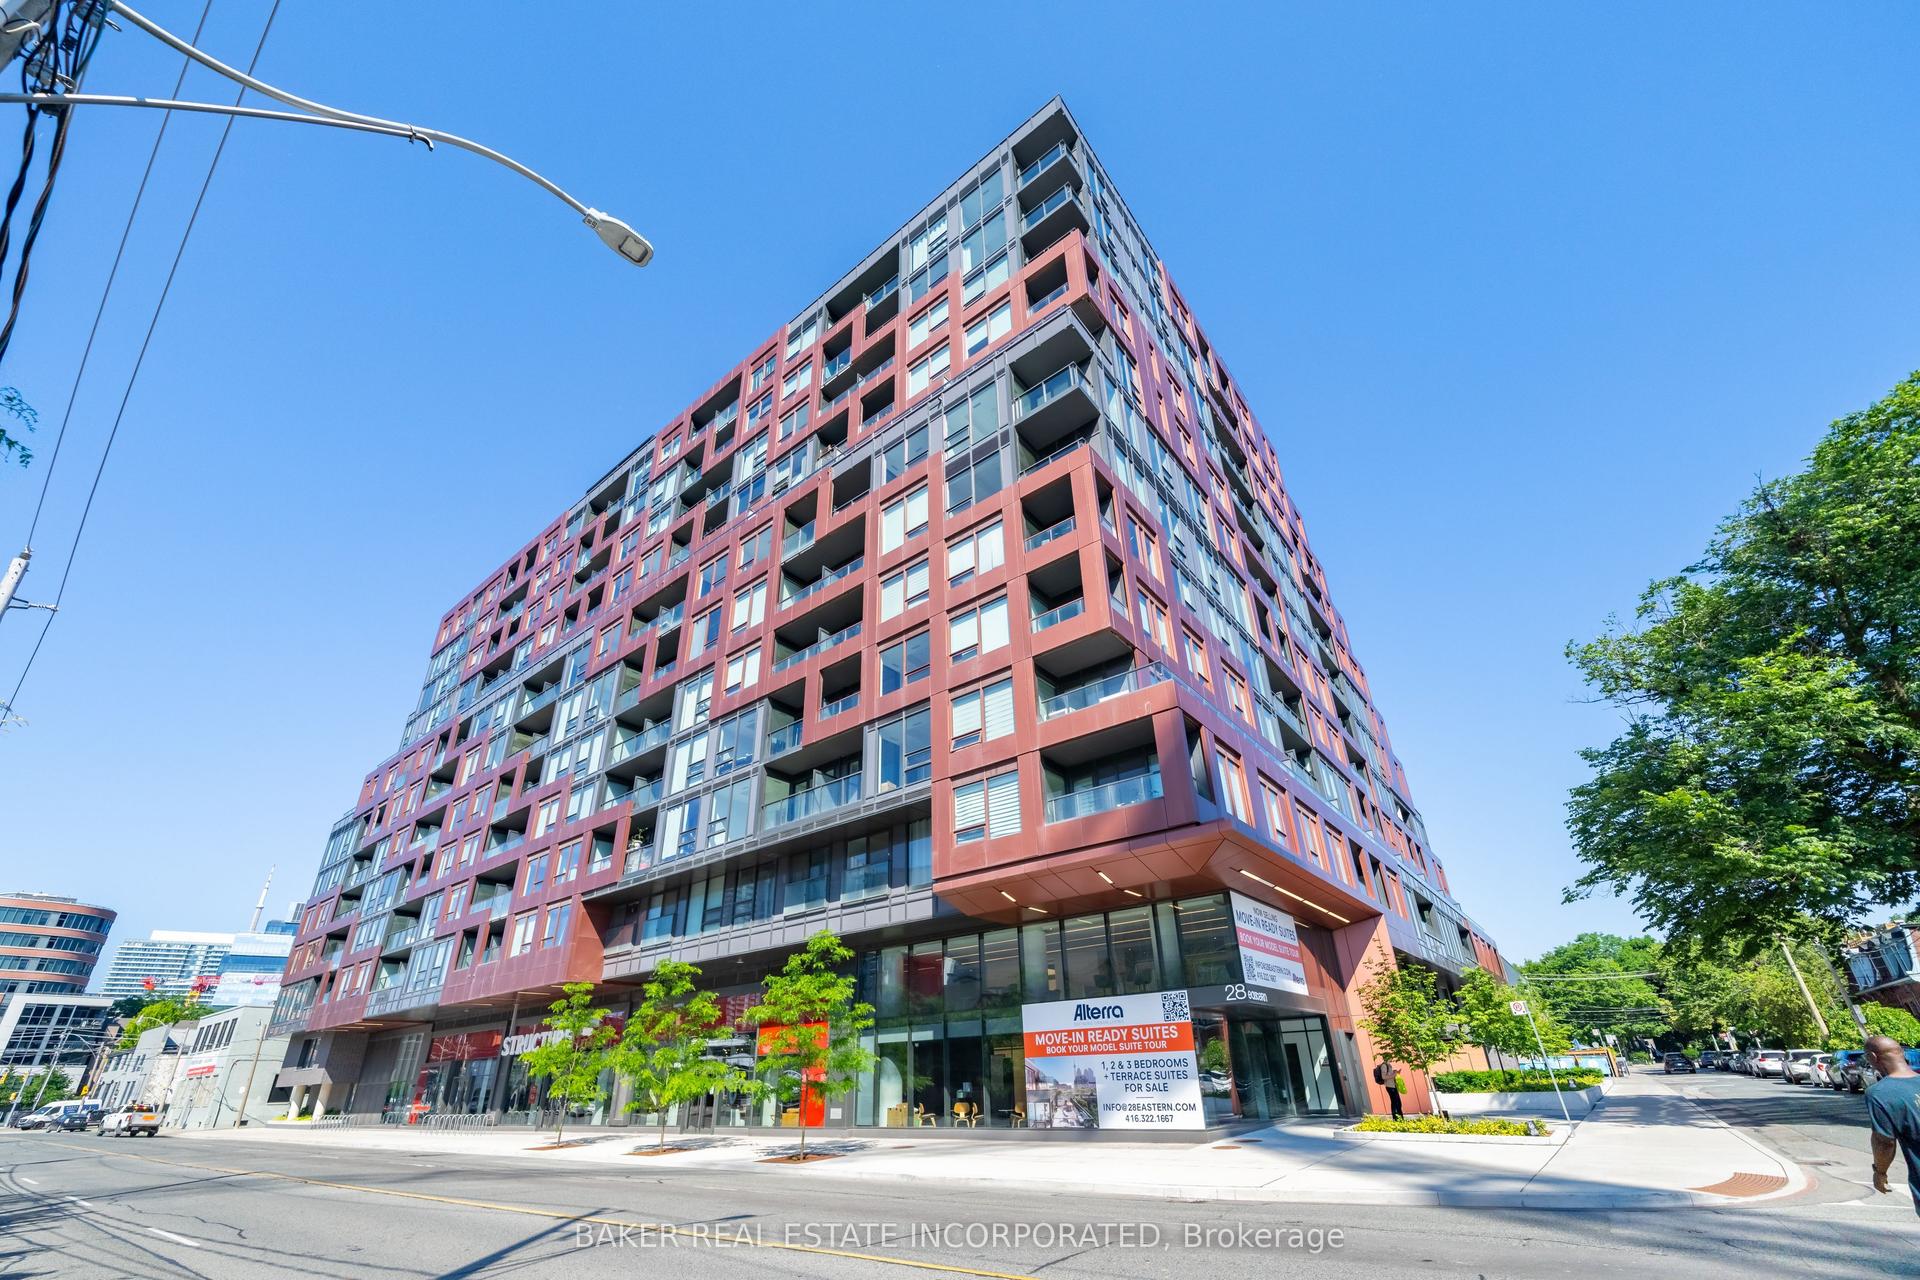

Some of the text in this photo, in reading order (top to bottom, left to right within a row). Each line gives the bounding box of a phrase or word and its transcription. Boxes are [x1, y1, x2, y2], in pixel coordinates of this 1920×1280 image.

[1236, 910, 1296, 941] MOVE-IN READY SUITES
[1224, 984, 1246, 1000] 28
[1074, 1004, 1124, 1021] Alterra
[1035, 1025, 1178, 1046] MOVE-IN READY SUITES
[1046, 1040, 1167, 1054] BOOK YOUR MODEL SUITE TOUR
[1102, 1058, 1188, 1071] 1, 2 & 3 BEDROOMS
[1111, 1071, 1152, 1080] TERRACE
[1155, 1070, 1188, 1080] SUITES
[1125, 1082, 1168, 1092] FOR SALE
[1103, 1103, 1196, 1111] INFO@28EASTERN.COM
